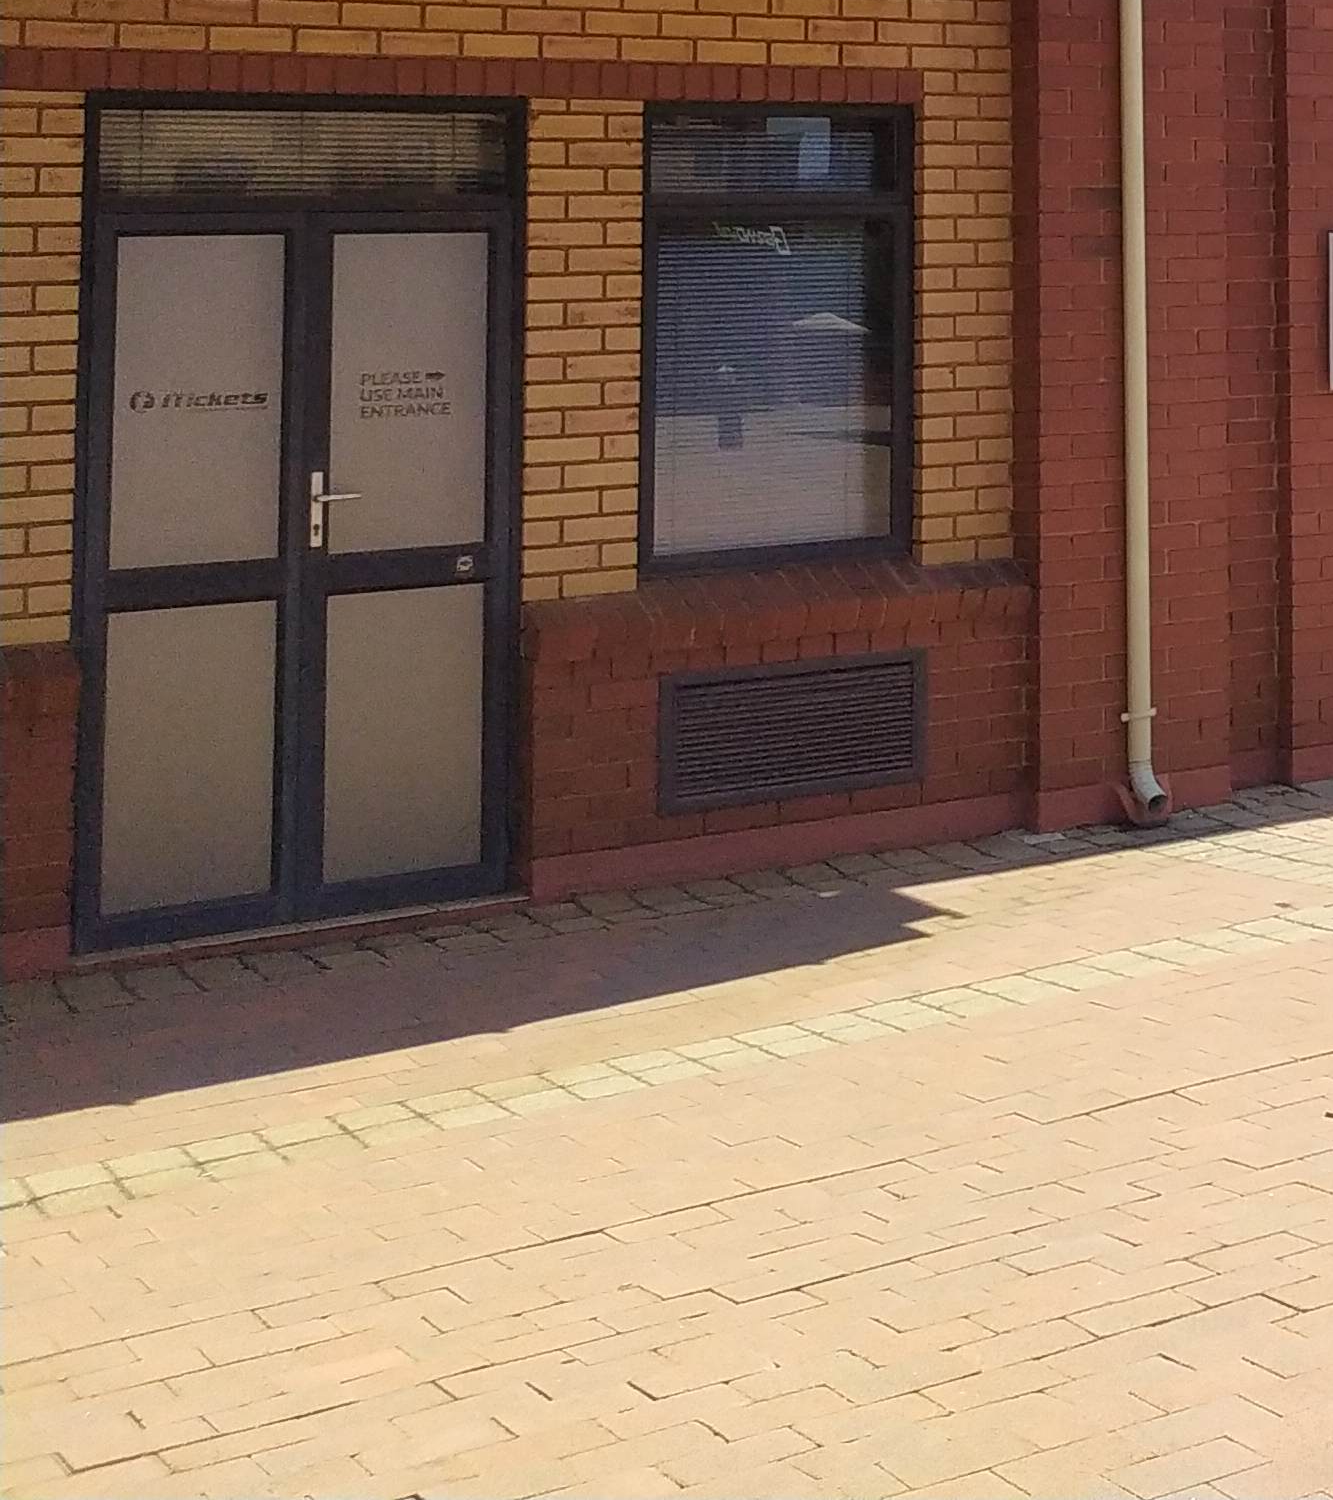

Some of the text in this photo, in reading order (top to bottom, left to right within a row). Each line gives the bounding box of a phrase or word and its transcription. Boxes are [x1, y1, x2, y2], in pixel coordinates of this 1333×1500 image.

[360, 371, 422, 386] PLEASE
[360, 387, 393, 402] USE
[360, 401, 452, 419] ENTRANCE
